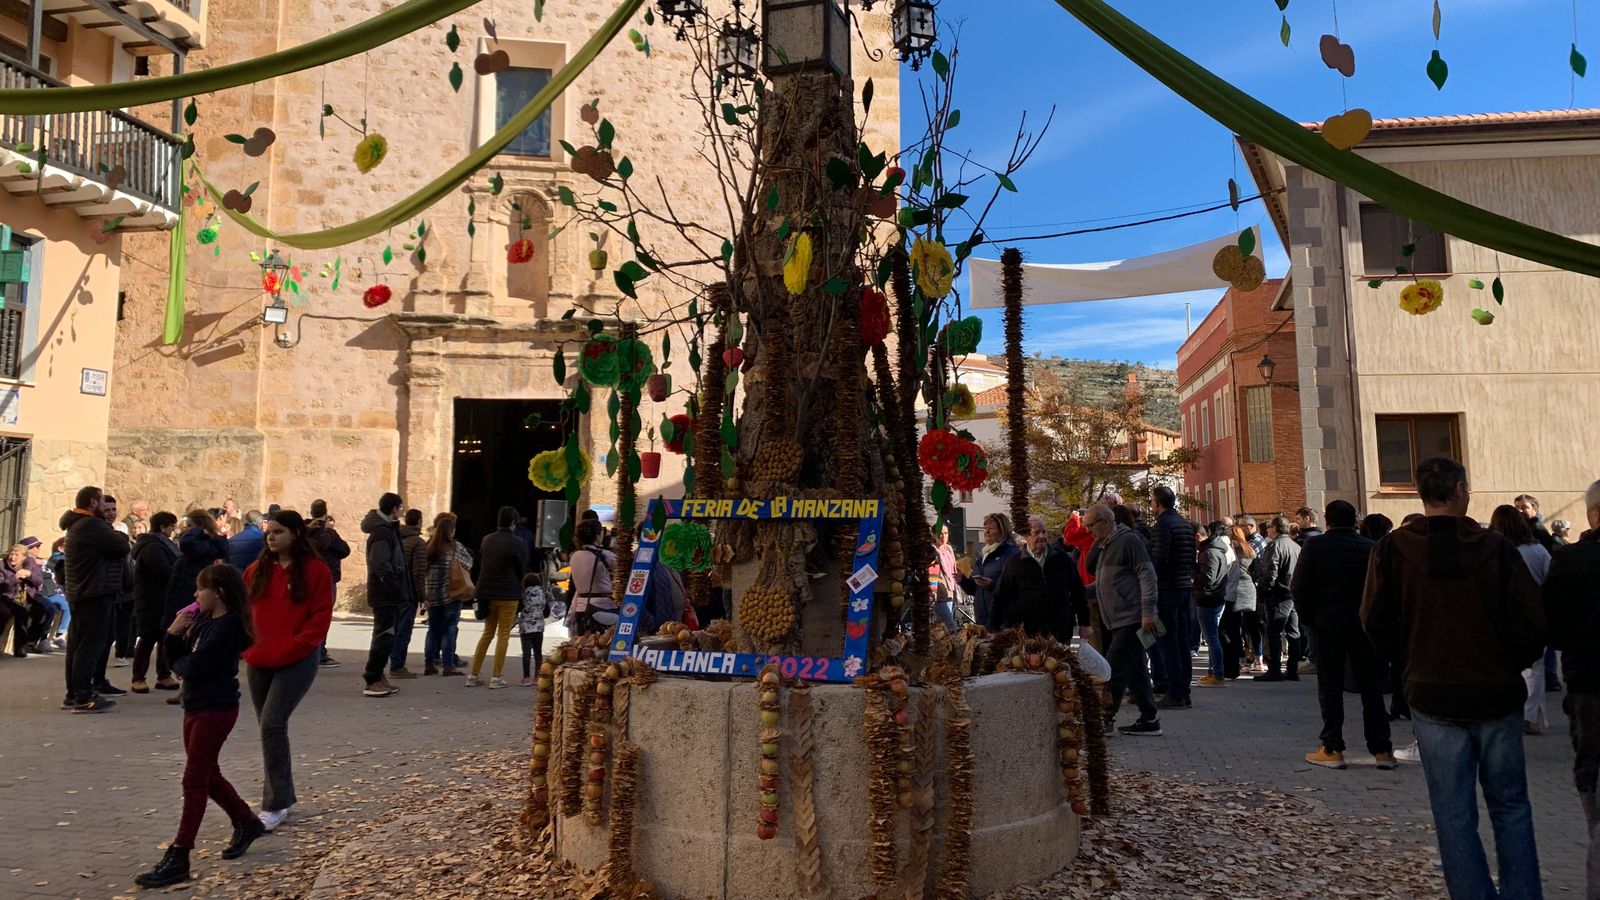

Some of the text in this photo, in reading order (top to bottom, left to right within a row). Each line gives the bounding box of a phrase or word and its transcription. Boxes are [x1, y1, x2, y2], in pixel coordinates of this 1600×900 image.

[680, 499, 733, 518] FERIA
[735, 498, 765, 520] DE
[770, 496, 787, 518] LA
[790, 499, 879, 518] MANZANA
[632, 644, 737, 674] VALLANCA
